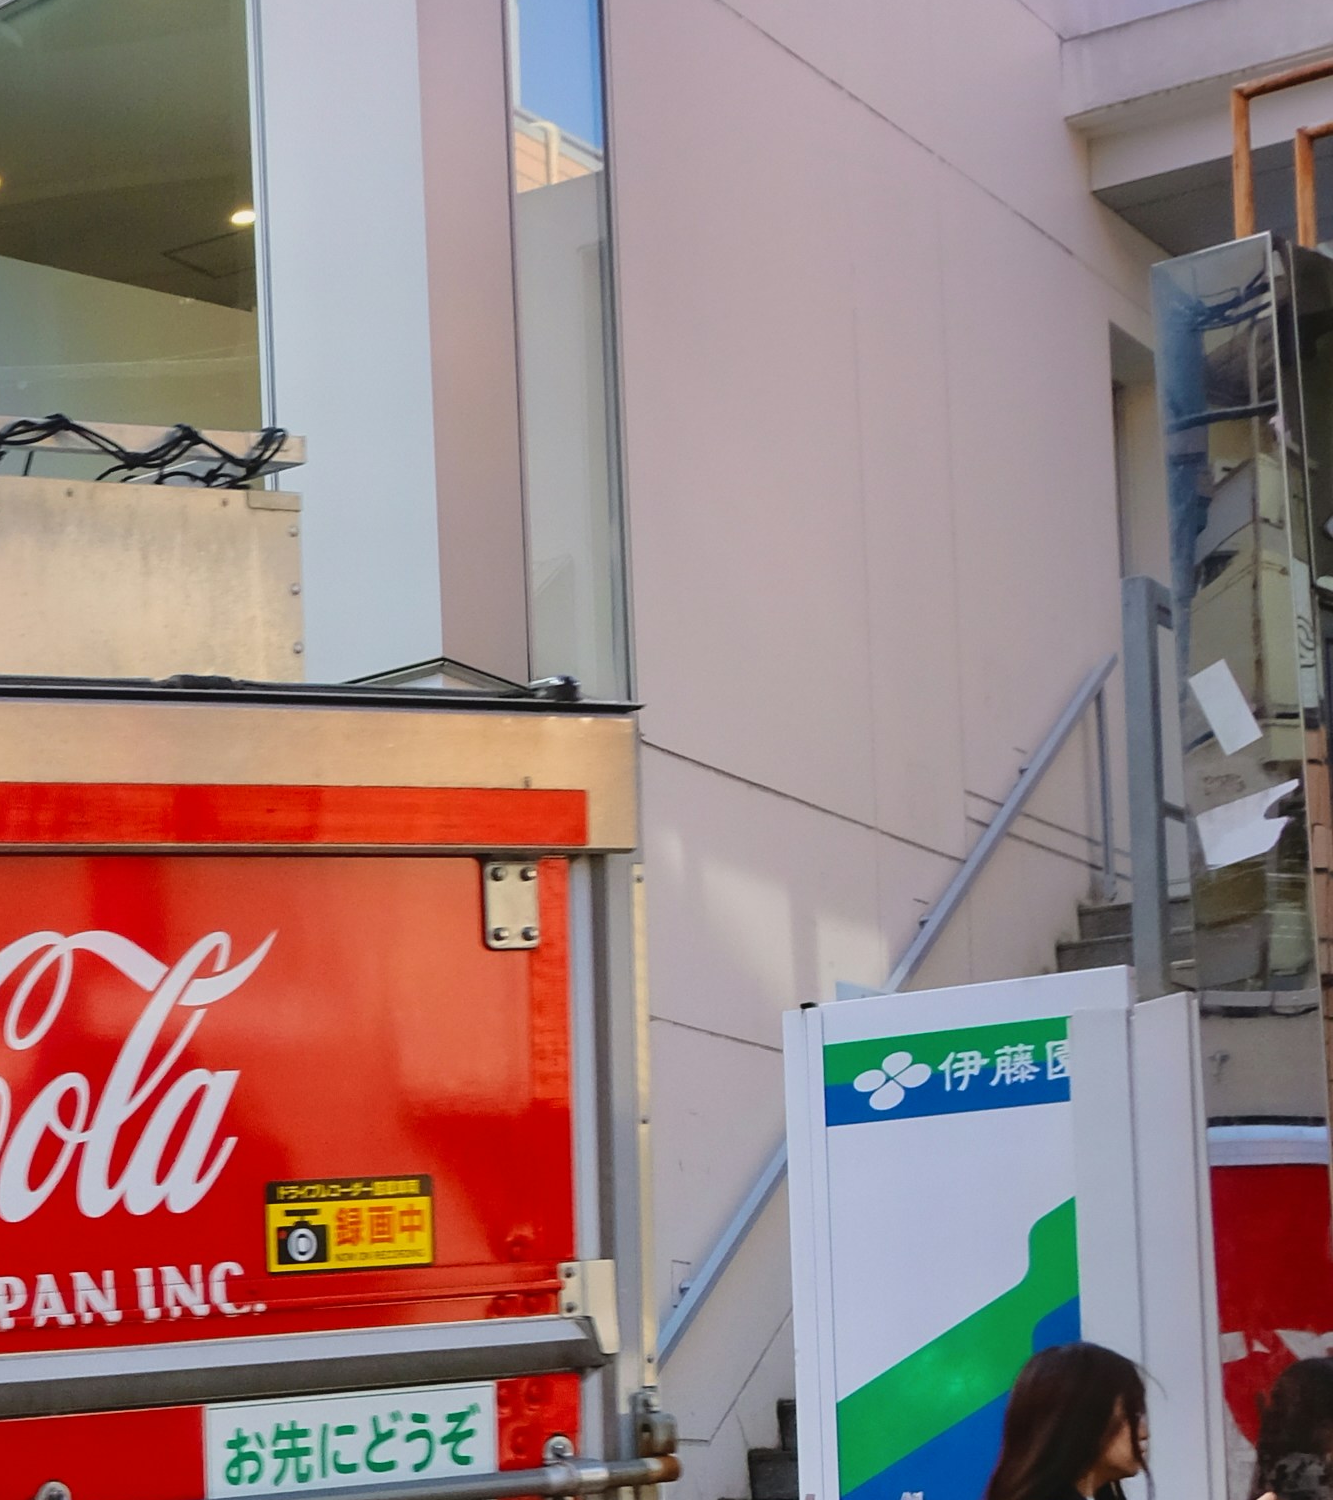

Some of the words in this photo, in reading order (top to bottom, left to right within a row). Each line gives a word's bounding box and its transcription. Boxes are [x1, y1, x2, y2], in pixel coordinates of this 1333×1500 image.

[336, 1204, 424, 1246] 録画中
[134, 1262, 267, 1323] INC.
[225, 1403, 481, 1486] お先にどうぞ
